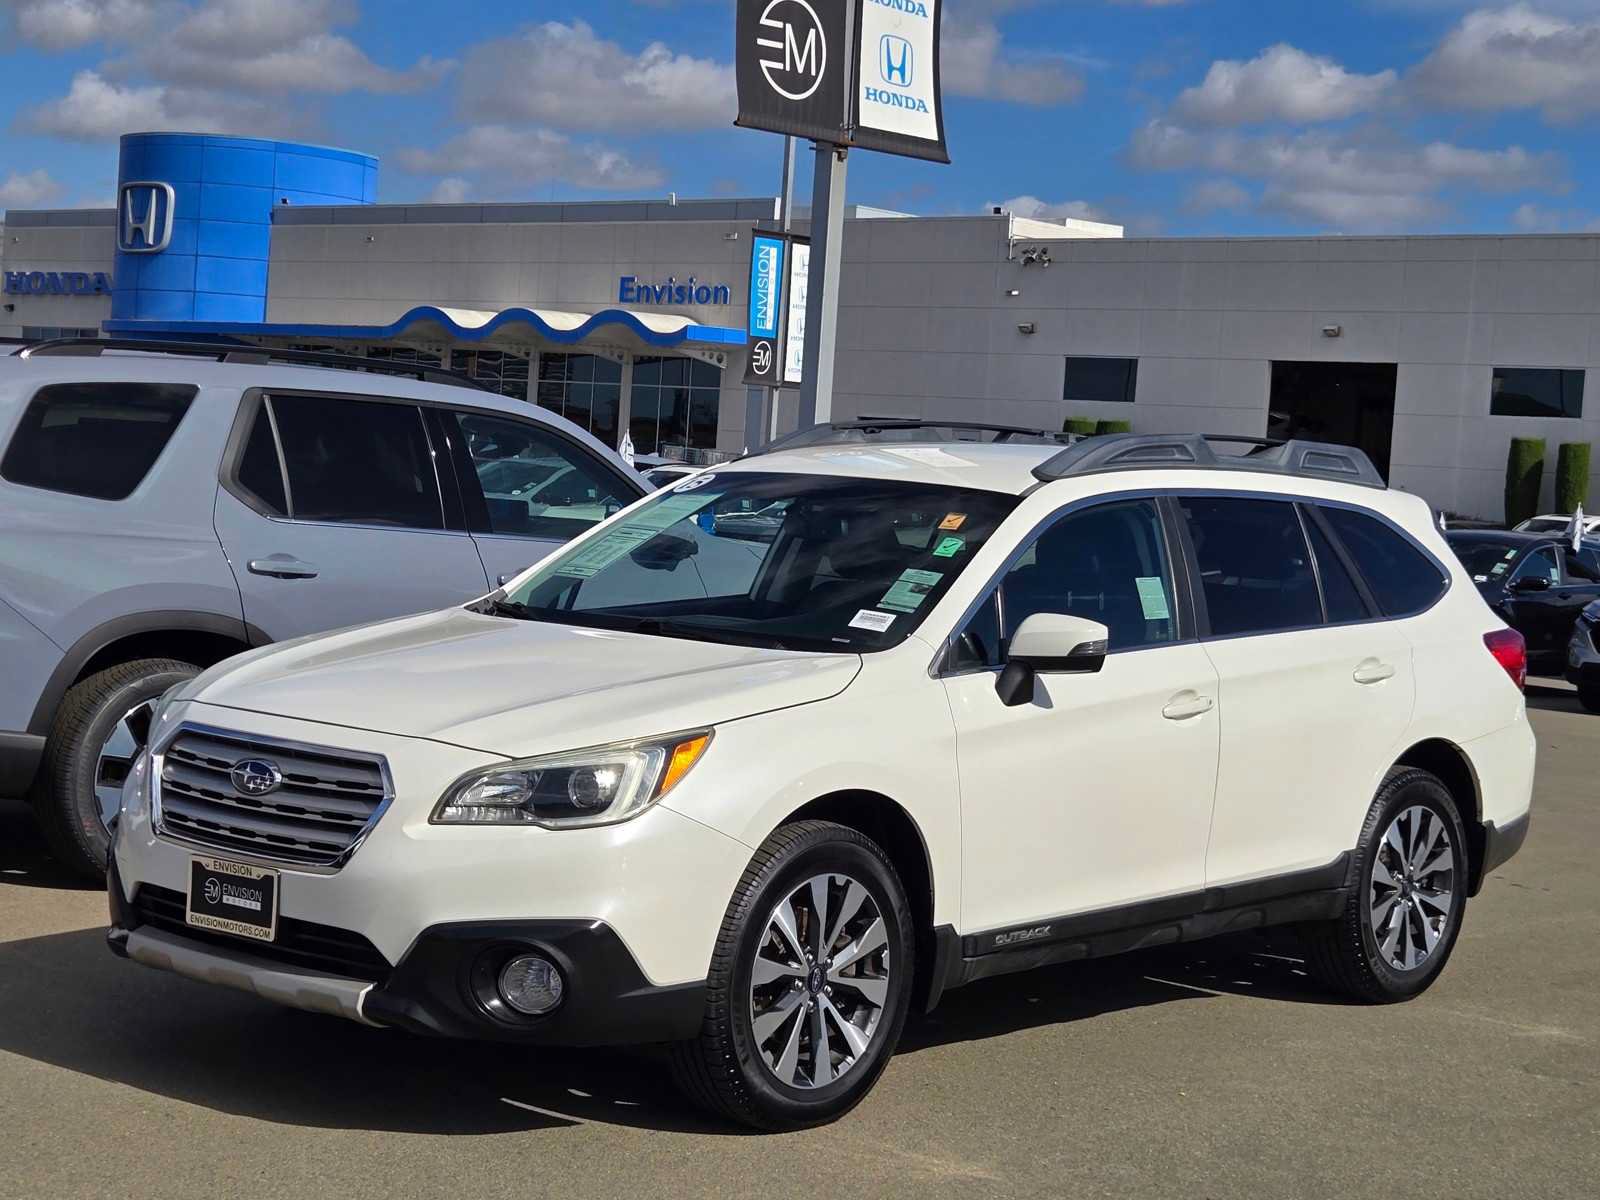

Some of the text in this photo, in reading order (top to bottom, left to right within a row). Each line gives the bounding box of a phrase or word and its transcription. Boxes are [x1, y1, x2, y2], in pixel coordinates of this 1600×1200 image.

[864, 87, 930, 113] HONDA
[4, 271, 112, 296] HONDA
[619, 275, 730, 305] Envision
[756, 245, 770, 329] ENVISION
[213, 860, 253, 877] ENVISION
[222, 883, 262, 902] ENVISION
[190, 915, 271, 940] ENVISIONMOTORS.COM
[995, 925, 1052, 944] OUTBACK
